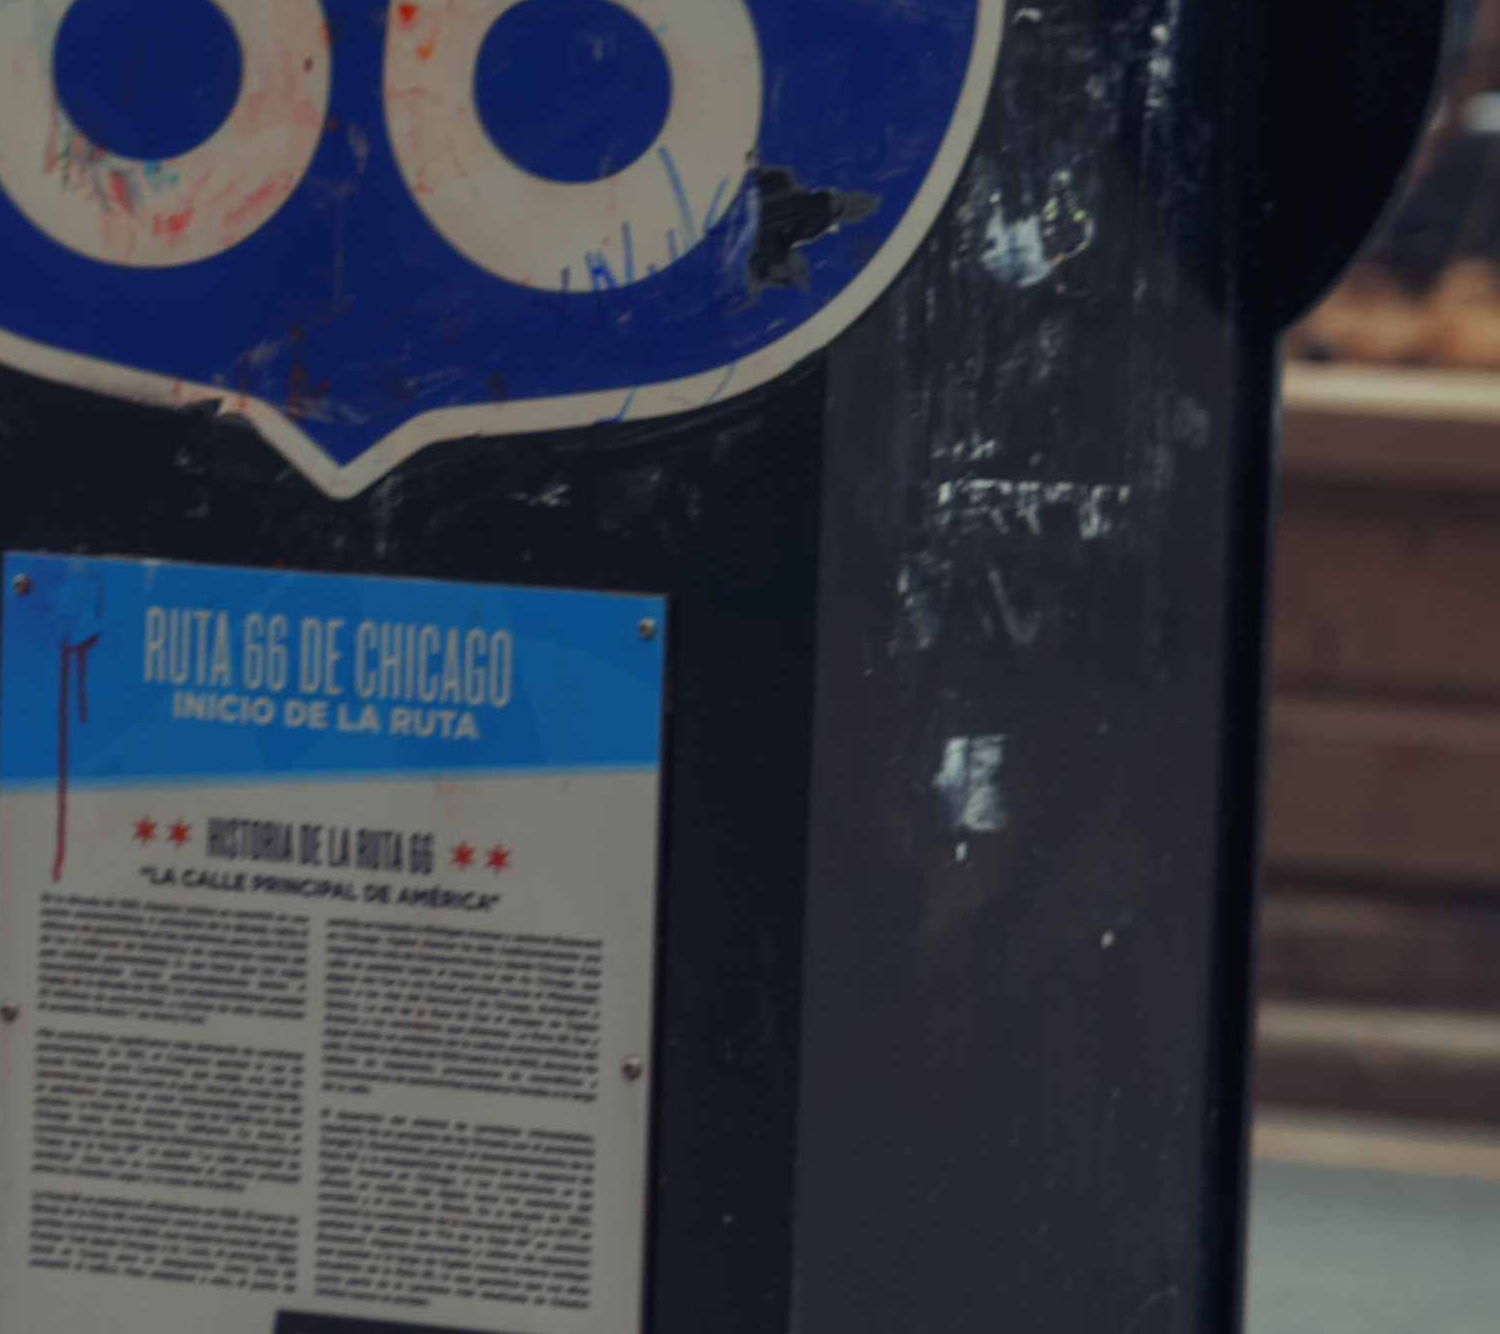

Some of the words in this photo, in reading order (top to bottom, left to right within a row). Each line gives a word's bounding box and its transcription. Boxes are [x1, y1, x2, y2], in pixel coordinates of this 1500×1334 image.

[142, 604, 231, 685] RUTA
[242, 612, 289, 693] 66
[299, 616, 346, 697] DE
[354, 619, 514, 709] CHICAGO
[171, 691, 275, 727] INICIO
[283, 698, 329, 730] DE
[337, 703, 382, 734] LA
[389, 707, 480, 743] RUTA
[205, 816, 294, 865] HISTORIA
[298, 823, 324, 867] DE
[327, 826, 351, 870] LA
[355, 828, 404, 872] RUTA
[408, 832, 436, 876] 66
[181, 868, 246, 893] CALLE
[251, 874, 357, 903] PRINCIPAL
[361, 882, 392, 905] DE
